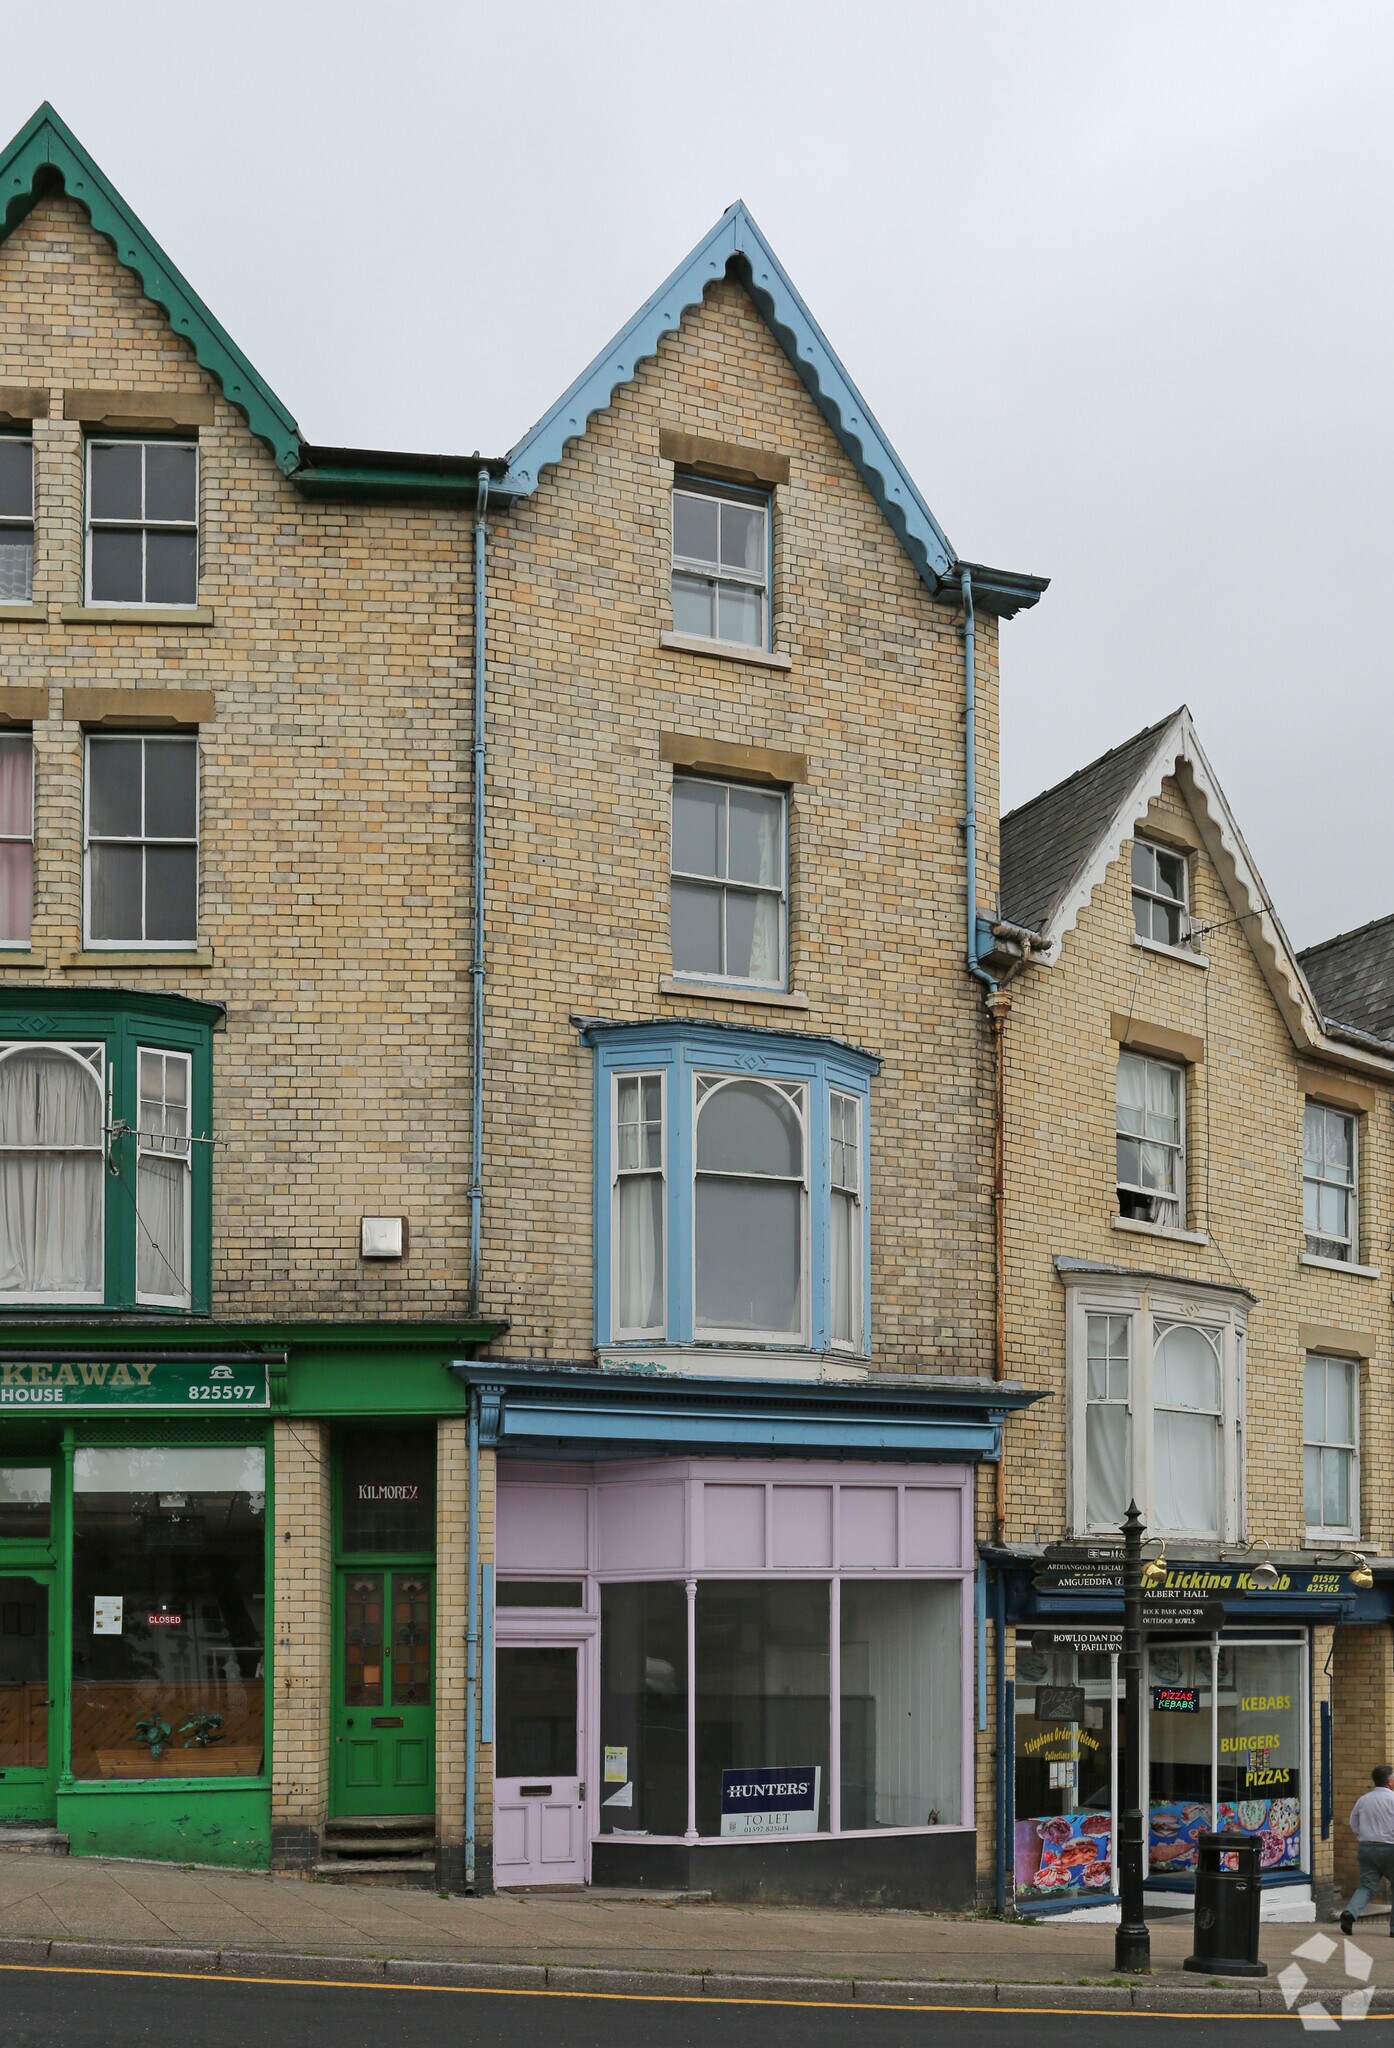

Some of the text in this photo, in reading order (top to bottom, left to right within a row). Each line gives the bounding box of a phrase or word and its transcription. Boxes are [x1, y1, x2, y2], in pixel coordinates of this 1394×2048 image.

[0, 1363, 157, 1385] KEAWAY
[1, 1388, 63, 1402] HOUSE
[188, 1386, 255, 1400] 825597
[1058, 1577, 1112, 1586] AMGUEDDFA
[1165, 1571, 1232, 1589] Licking
[1312, 1575, 1340, 1583] 01597
[1144, 1590, 1209, 1598] ALBERT HALL
[1306, 1583, 1340, 1592] 825165
[148, 1616, 181, 1624] CLOSED
[1053, 1634, 1088, 1642] BOWLIO
[1073, 1643, 1123, 1651] Y PAFILIWN
[1160, 1691, 1193, 1700] PIZZAS
[1158, 1700, 1194, 1709] KEBABS
[1241, 1696, 1291, 1712] KEBABS
[1024, 1732, 1054, 1755] Telephone
[1221, 1734, 1281, 1752] BURGERS
[1245, 1768, 1290, 1787] PIZZAS
[727, 1782, 809, 1798] HUNTERS
[744, 1813, 791, 1826] TO LET
